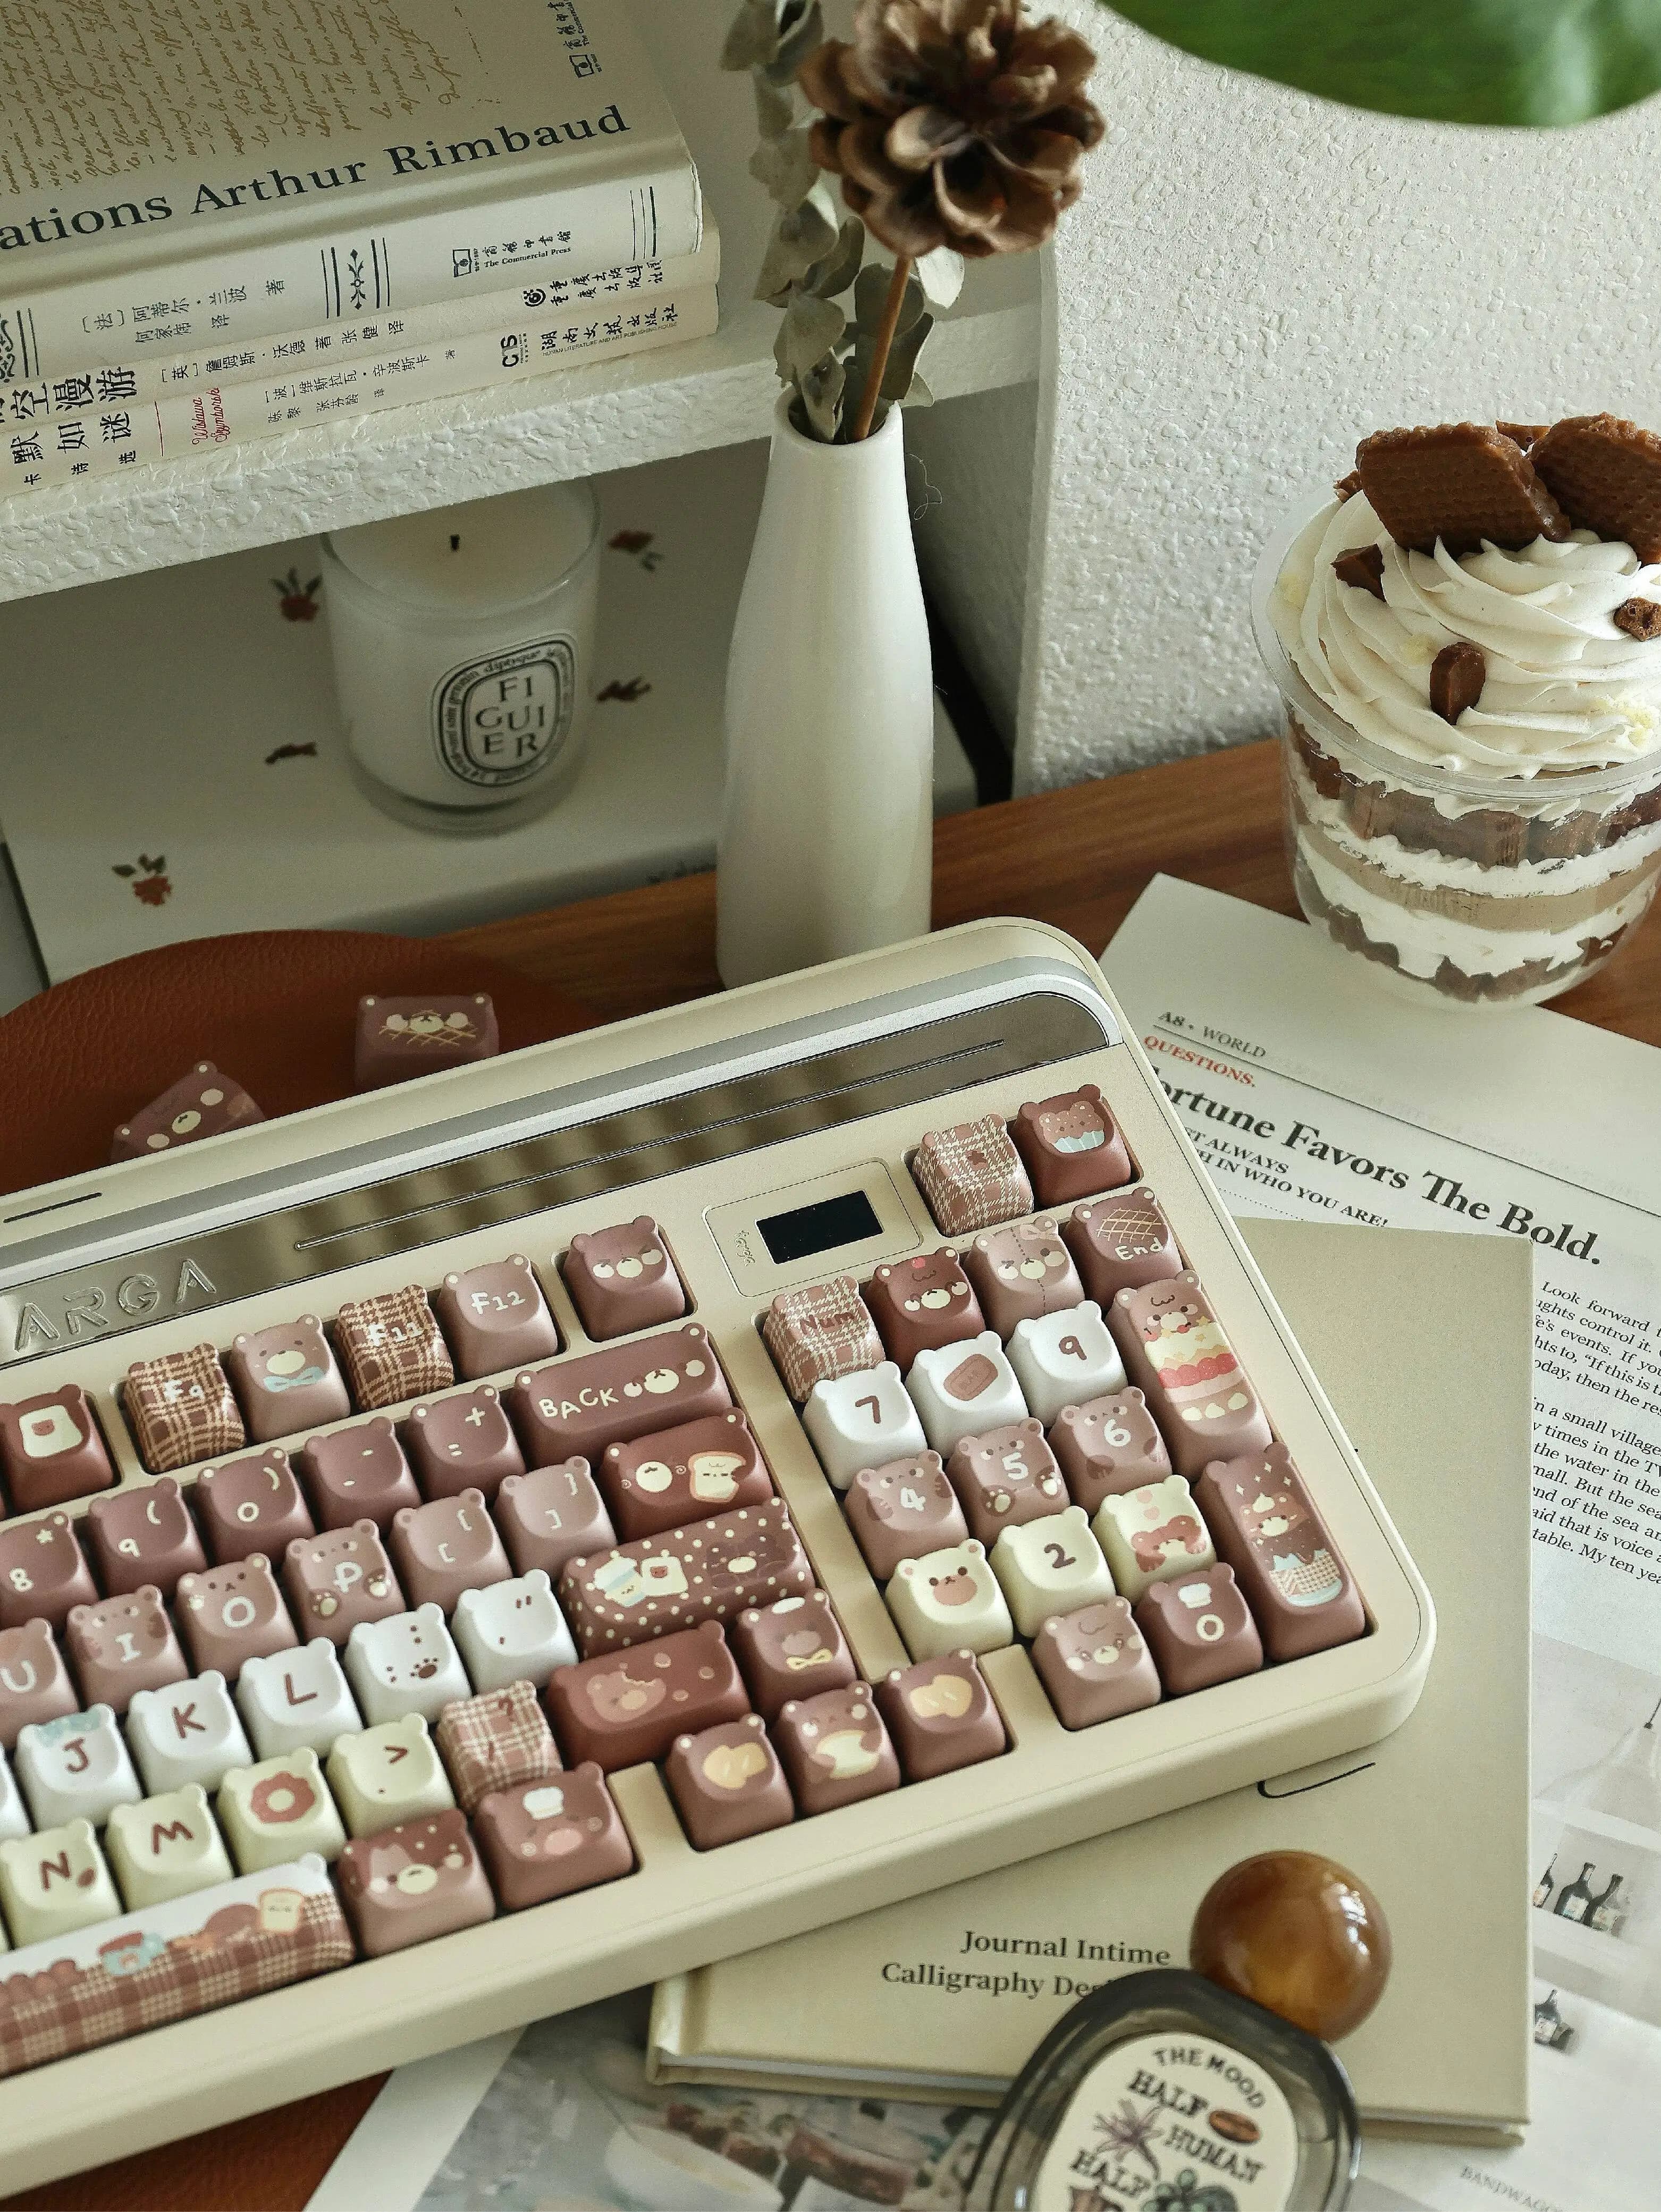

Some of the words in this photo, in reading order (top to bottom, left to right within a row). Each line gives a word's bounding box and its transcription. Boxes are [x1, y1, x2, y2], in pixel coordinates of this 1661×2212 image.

[190, 161, 366, 214] Arthur
[383, 105, 631, 175] Rimbaud
[484, 259, 500, 268] The
[502, 251, 549, 264] Commercial
[551, 246, 571, 256] Press
[0, 366, 138, 423] 空漫游
[499, 676, 532, 702] FI
[483, 732, 538, 758] ER
[1158, 1011, 1186, 1026] A8
[1202, 1025, 1267, 1058] WORLD
[1143, 1035, 1255, 1087] QUESTIONS.
[1205, 1138, 1289, 1173] ALWAYS
[1215, 1157, 1241, 1172] IN
[1244, 1167, 1293, 1192] WHO
[1296, 1185, 1340, 1210] YOU
[1339, 1204, 1389, 1228] ARE!
[1281, 1120, 1410, 1189] Favors
[1421, 1169, 1490, 1220] The
[1496, 1202, 1600, 1265] Bold.
[1116, 1236, 1164, 1261] End
[14, 1259, 216, 1353] ARGA
[471, 1291, 525, 1315] F12
[1541, 1281, 1581, 1305] Look
[1587, 1300, 1651, 1332] forward
[368, 1320, 424, 1347] F11
[1058, 1335, 1088, 1362] 9
[1561, 1329, 1612, 1356] events.
[1619, 1350, 1638, 1364] If
[1579, 1317, 1635, 1345] control
[1637, 1338, 1652, 1353] it.
[1560, 1346, 1578, 1364] to,
[1605, 1365, 1634, 1383] this
[1635, 1376, 1650, 1390] is
[538, 1387, 618, 1420] BACK
[1575, 1373, 1611, 1395] then
[1613, 1389, 1640, 1406] the
[854, 1394, 882, 1424] 7
[1549, 1407, 1558, 1417] a
[1562, 1412, 1607, 1434] small
[1103, 1418, 1132, 1448] 6
[1545, 1425, 1589, 1448] times
[1593, 1441, 1609, 1456] in
[1614, 1450, 1640, 1467] the
[1000, 1451, 1030, 1481] 5
[1533, 1442, 1559, 1459] the
[1565, 1454, 1609, 1476] water
[1612, 1470, 1629, 1485] in
[1634, 1479, 1660, 1497] the
[898, 1486, 926, 1513] 4
[1574, 1477, 1604, 1497] But
[1608, 1490, 1634, 1508] the
[1561, 1497, 1581, 1509] of
[1582, 1502, 1609, 1520] the
[1612, 1515, 1640, 1532] sea
[1532, 1528, 1573, 1552] table.
[1578, 1543, 1607, 1564] My
[1609, 1555, 1635, 1574] ten
[1559, 1516, 1592, 1536] that
[1593, 1527, 1609, 1542] is
[1614, 1536, 1654, 1558] voice
[1043, 1541, 1076, 1570] 2
[9, 1568, 35, 1592] 8
[333, 1560, 362, 1593] P
[115, 1632, 142, 1663] I
[283, 1673, 318, 1706] L
[171, 1701, 206, 1739] K
[62, 1737, 90, 1772] J
[150, 1819, 193, 1855] M
[39, 1850, 72, 1890] N
[960, 1930, 1067, 1958] Journal
[1076, 1939, 1171, 1966] Intime
[881, 1961, 1044, 2000] Calligraphy
[1126, 2069, 1209, 2117] HALF
[1153, 2047, 1204, 2066] THE
[1207, 2054, 1266, 2108] MOOD
[1164, 2125, 1266, 2184] HUMAN
[1069, 2148, 1150, 2199] HALF
